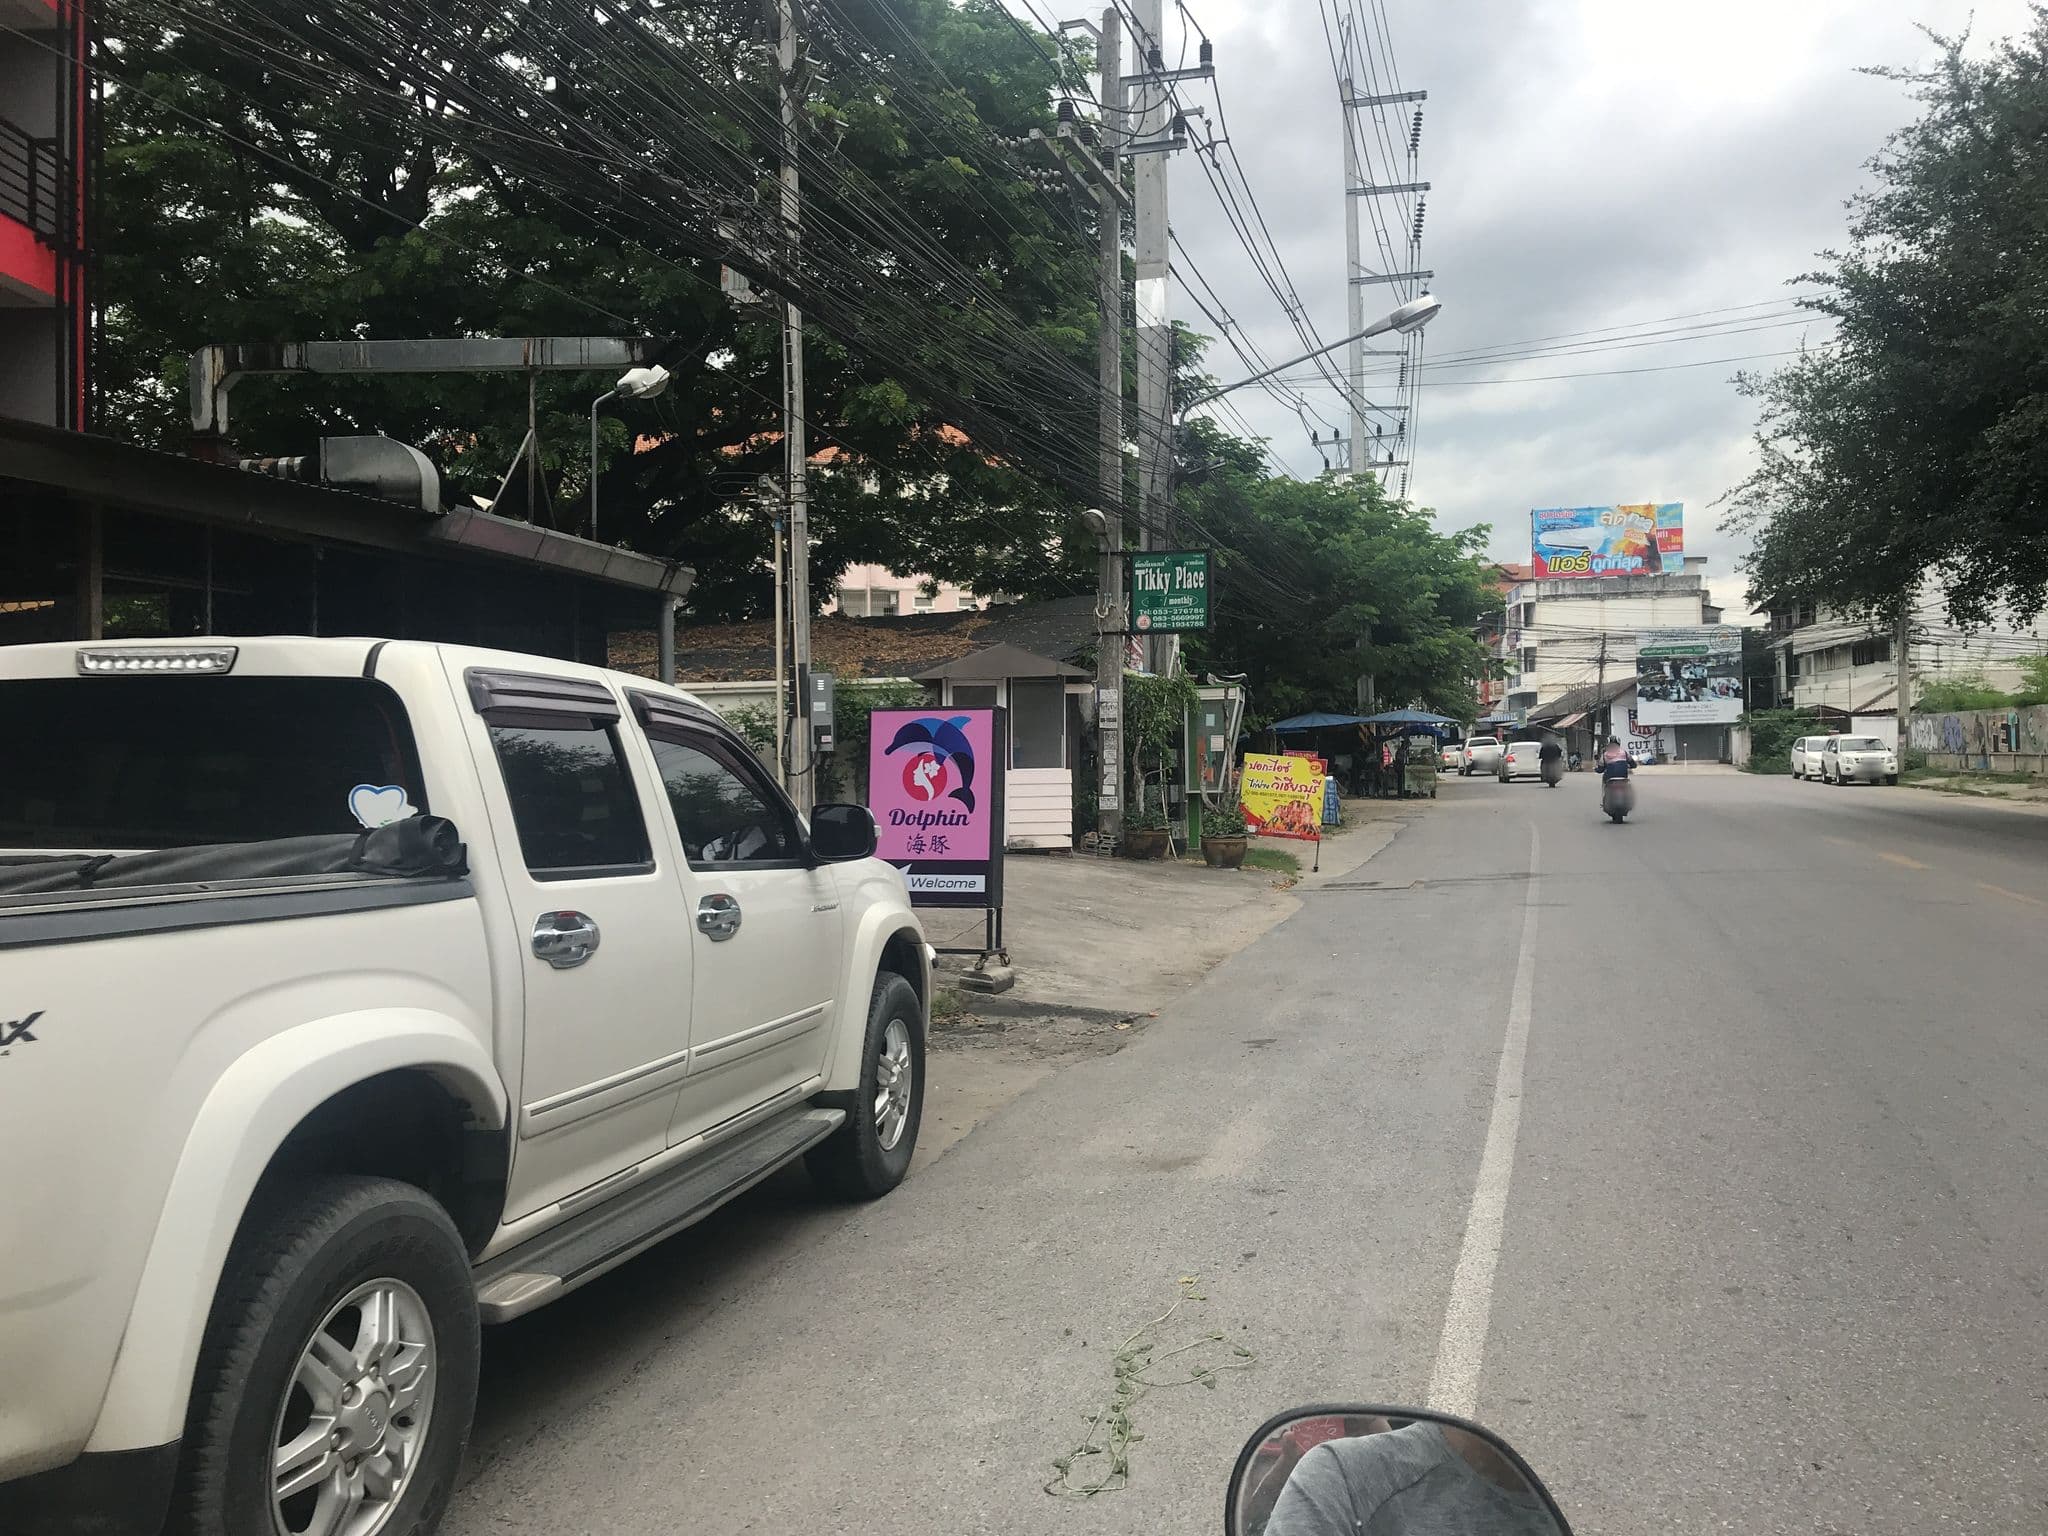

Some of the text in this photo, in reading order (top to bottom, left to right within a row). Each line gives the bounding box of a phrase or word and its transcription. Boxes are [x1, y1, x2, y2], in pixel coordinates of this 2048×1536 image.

[1549, 551, 1591, 573] แอร์
[1135, 566, 1205, 595] Tikky Place
[1168, 595, 1194, 606] monthly
[1627, 740, 1651, 750] CUT
[888, 808, 970, 831] Dolphin
[906, 833, 951, 855] 海豚
[911, 877, 977, 889] Welcome
